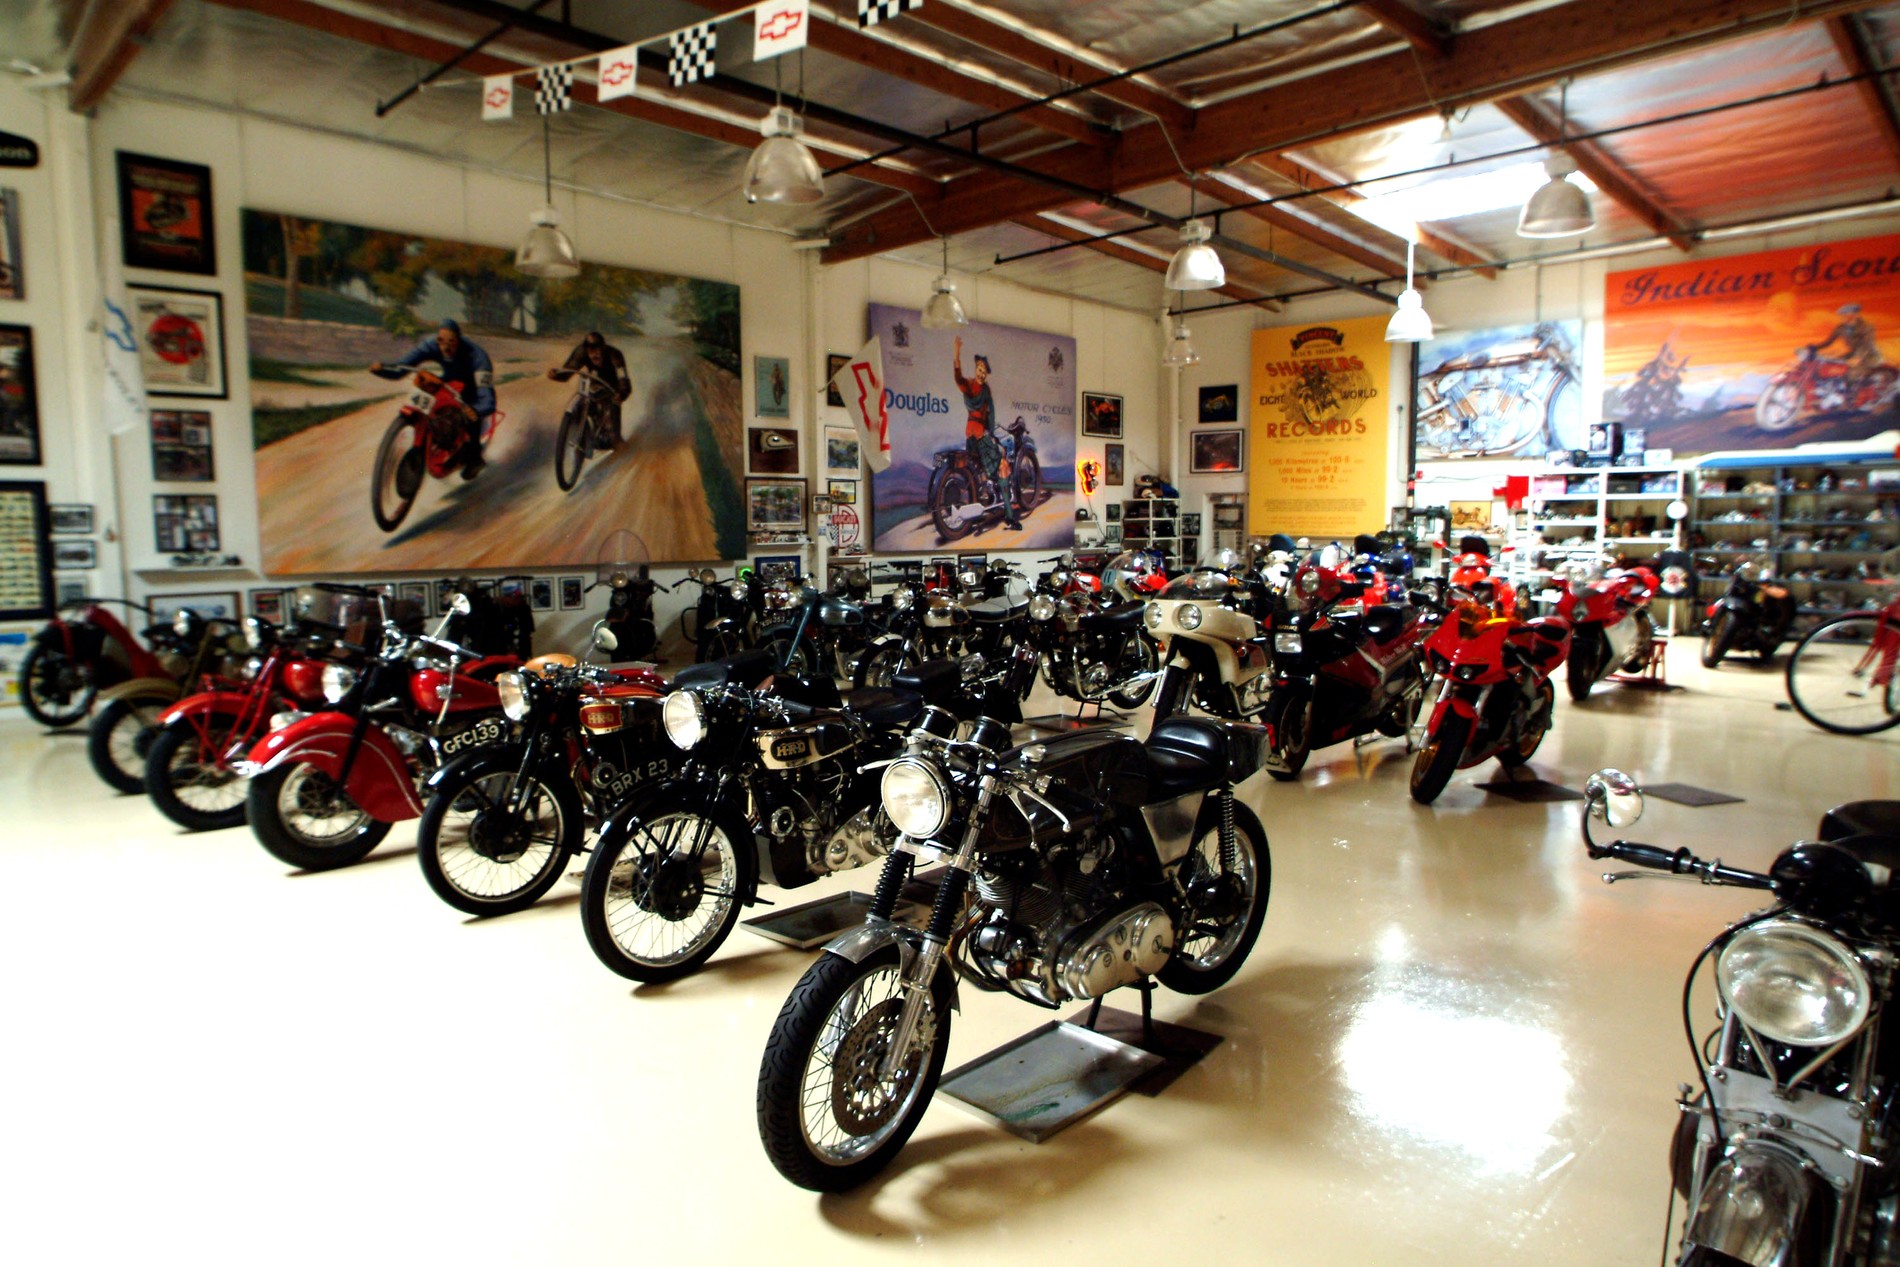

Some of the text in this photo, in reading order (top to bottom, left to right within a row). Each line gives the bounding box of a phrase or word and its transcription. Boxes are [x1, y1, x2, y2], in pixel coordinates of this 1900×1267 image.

[1620, 269, 1774, 306] Indian
[1265, 356, 1364, 377] SHATTERS
[884, 388, 949, 416] Douglas
[1260, 389, 1377, 406] EIGHT WORLD
[1010, 401, 1072, 416] MOTOR CYCLES
[1267, 418, 1366, 438] RECORDS
[611, 758, 668, 797] BRX 23
